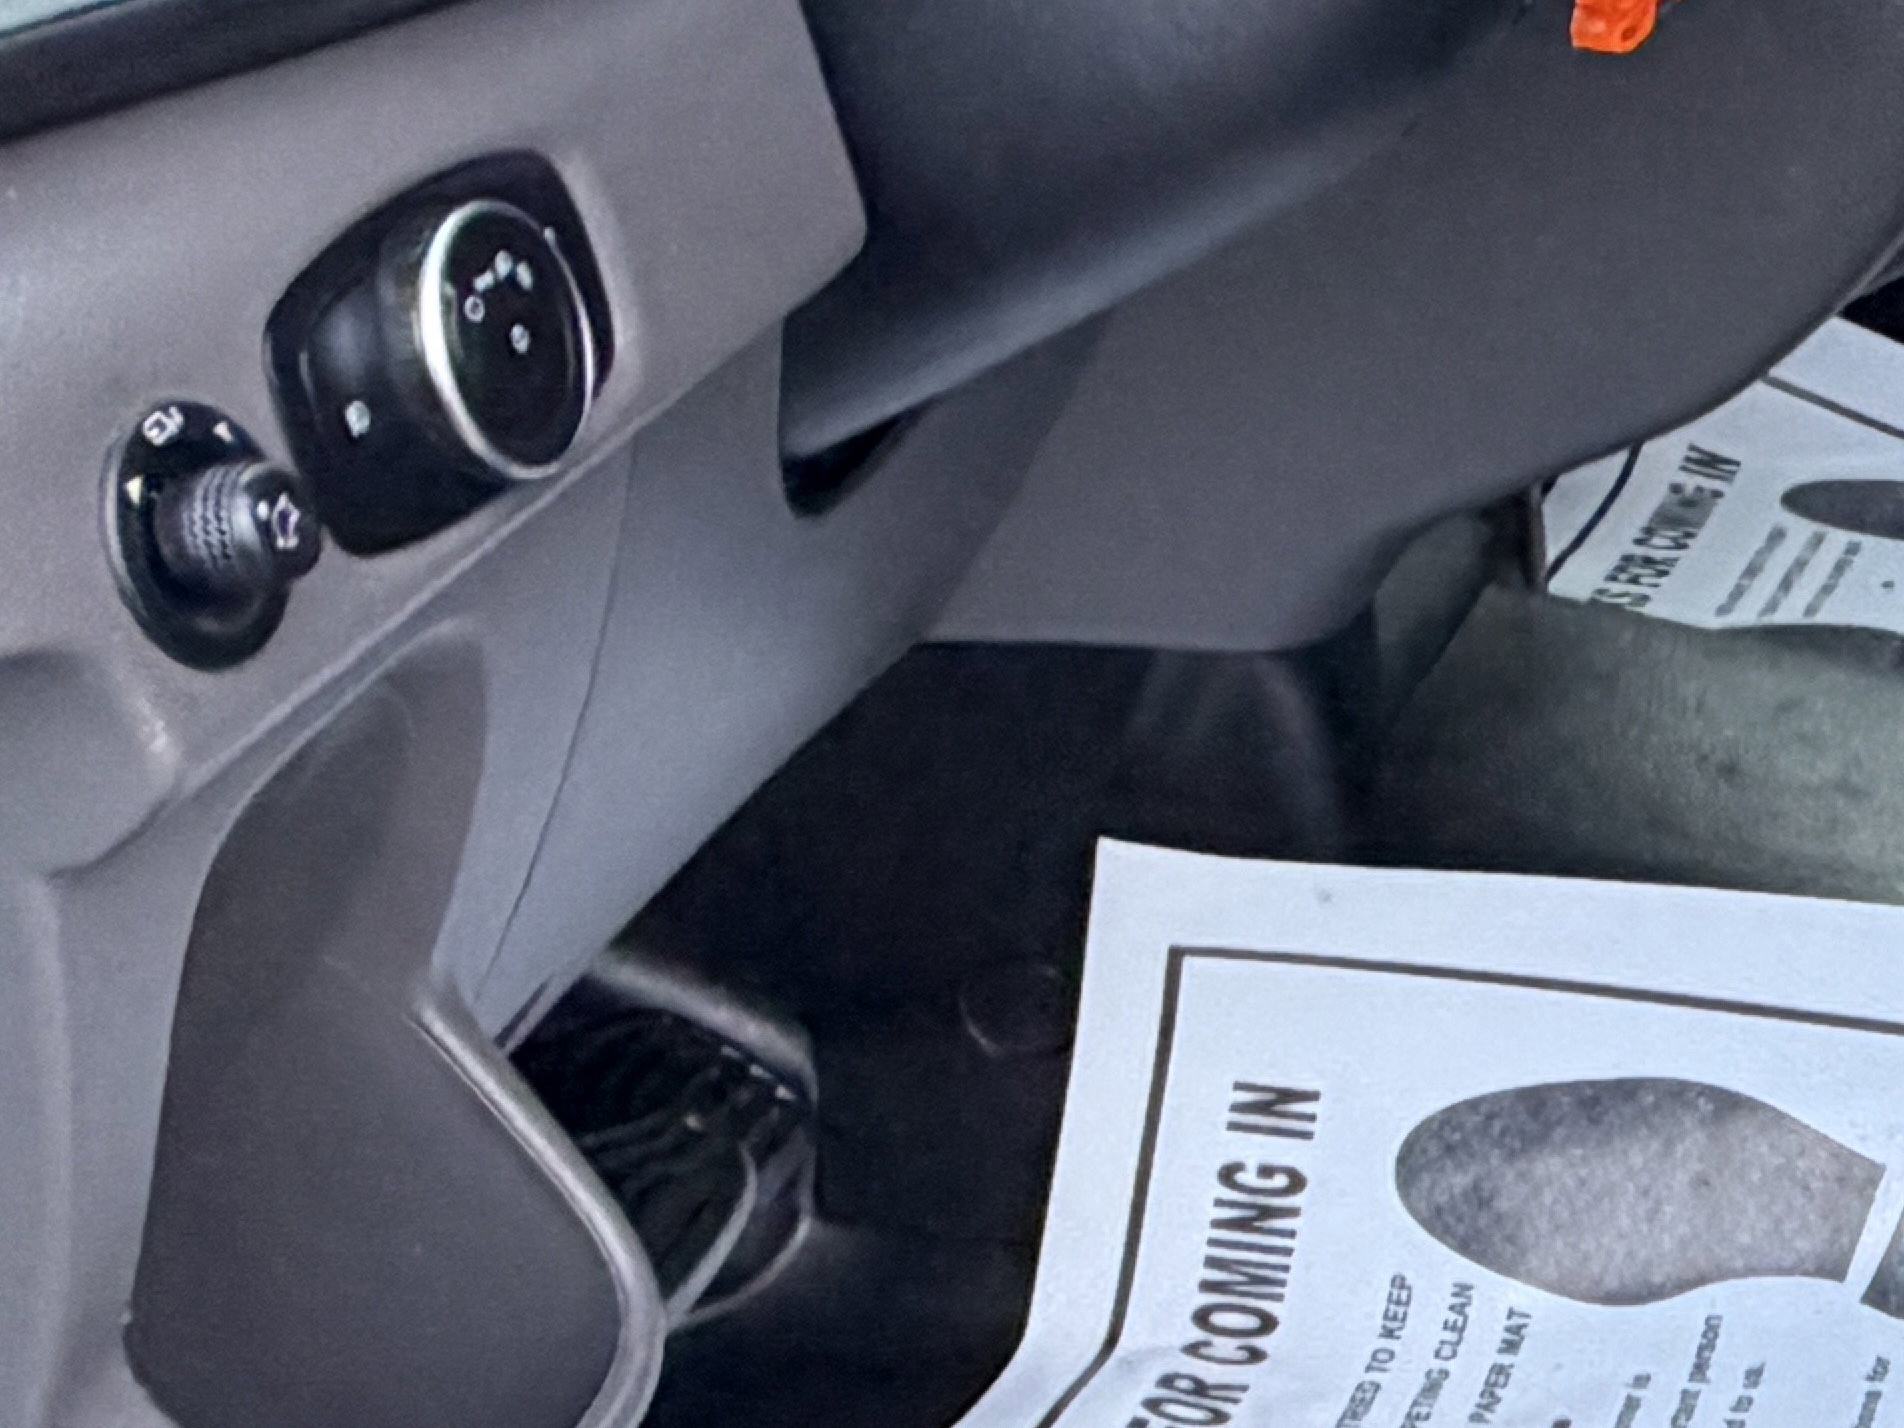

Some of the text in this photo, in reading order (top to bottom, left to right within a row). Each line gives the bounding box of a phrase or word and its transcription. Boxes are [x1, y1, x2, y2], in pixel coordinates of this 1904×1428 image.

[1678, 443, 1741, 485] IN
[1226, 1081, 1321, 1140] IN
[1180, 1161, 1308, 1365] COMING
[1379, 1274, 1413, 1340] KEEP
[1434, 1282, 1475, 1361] CLEAN
[1365, 1347, 1395, 1374] TO
[1469, 1363, 1516, 1424] PAPER
[1496, 1306, 1532, 1356] MAT
[1688, 1314, 1723, 1384] person
[1864, 1355, 1891, 1383] for
[1626, 1373, 1651, 1390] is
[1728, 1394, 1754, 1414] to
[1743, 1361, 1767, 1389] us.
